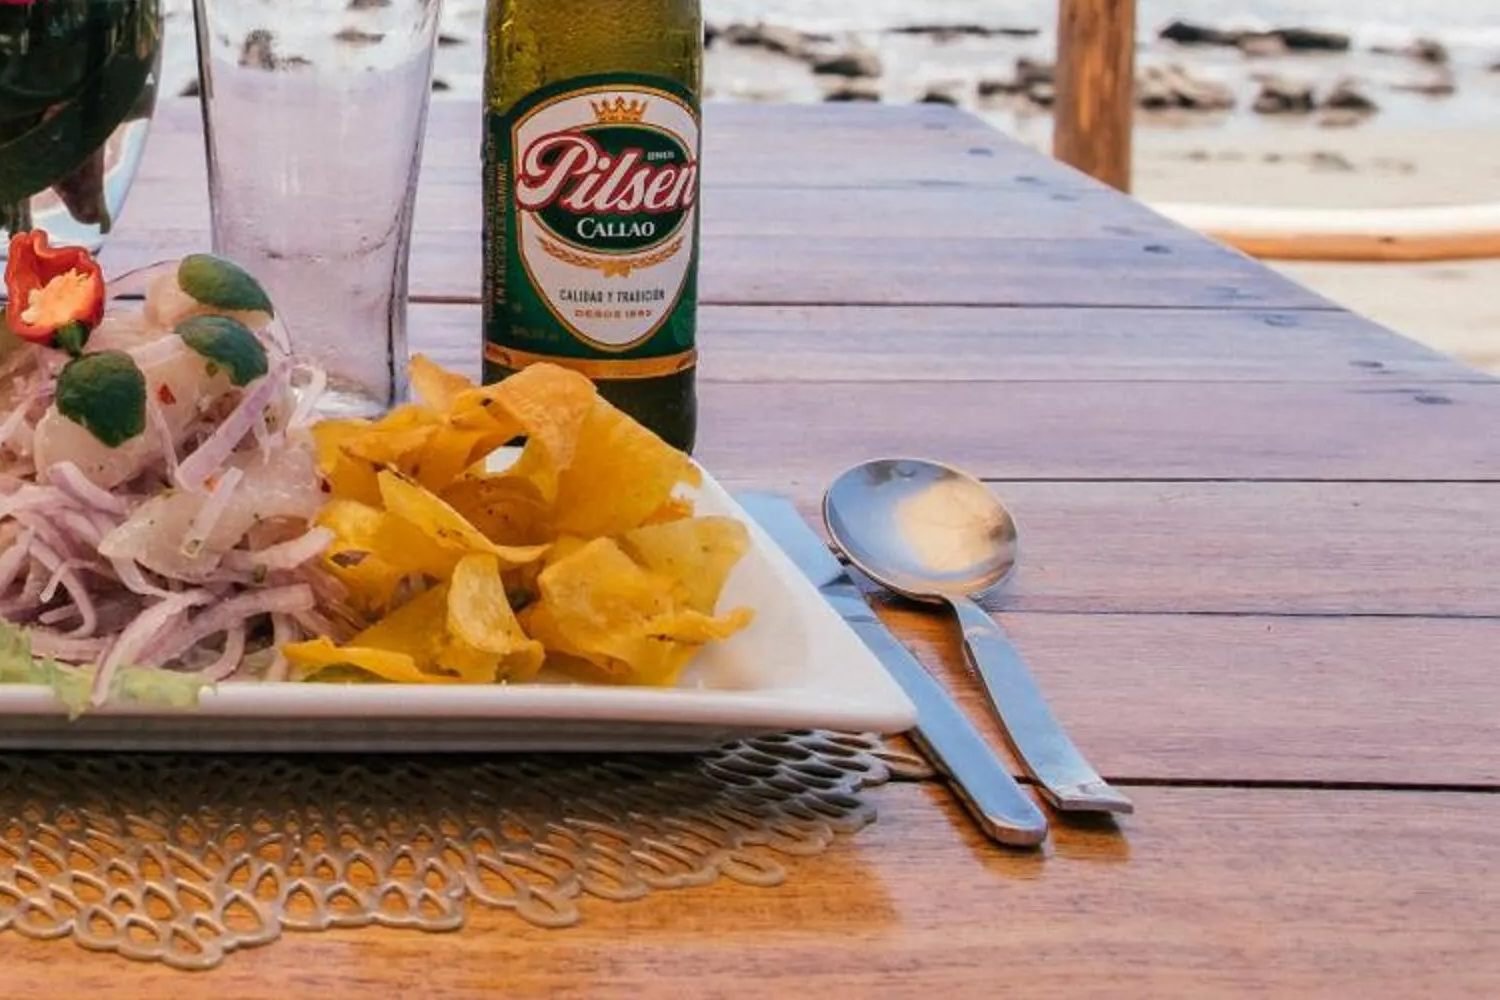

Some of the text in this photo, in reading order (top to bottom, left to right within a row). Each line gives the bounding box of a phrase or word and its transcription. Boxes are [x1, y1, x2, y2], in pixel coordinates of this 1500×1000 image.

[516, 133, 697, 212] Pilsen
[577, 217, 655, 239] CALLAO
[559, 288, 603, 303] CALIDAD
[607, 291, 613, 303] Y
